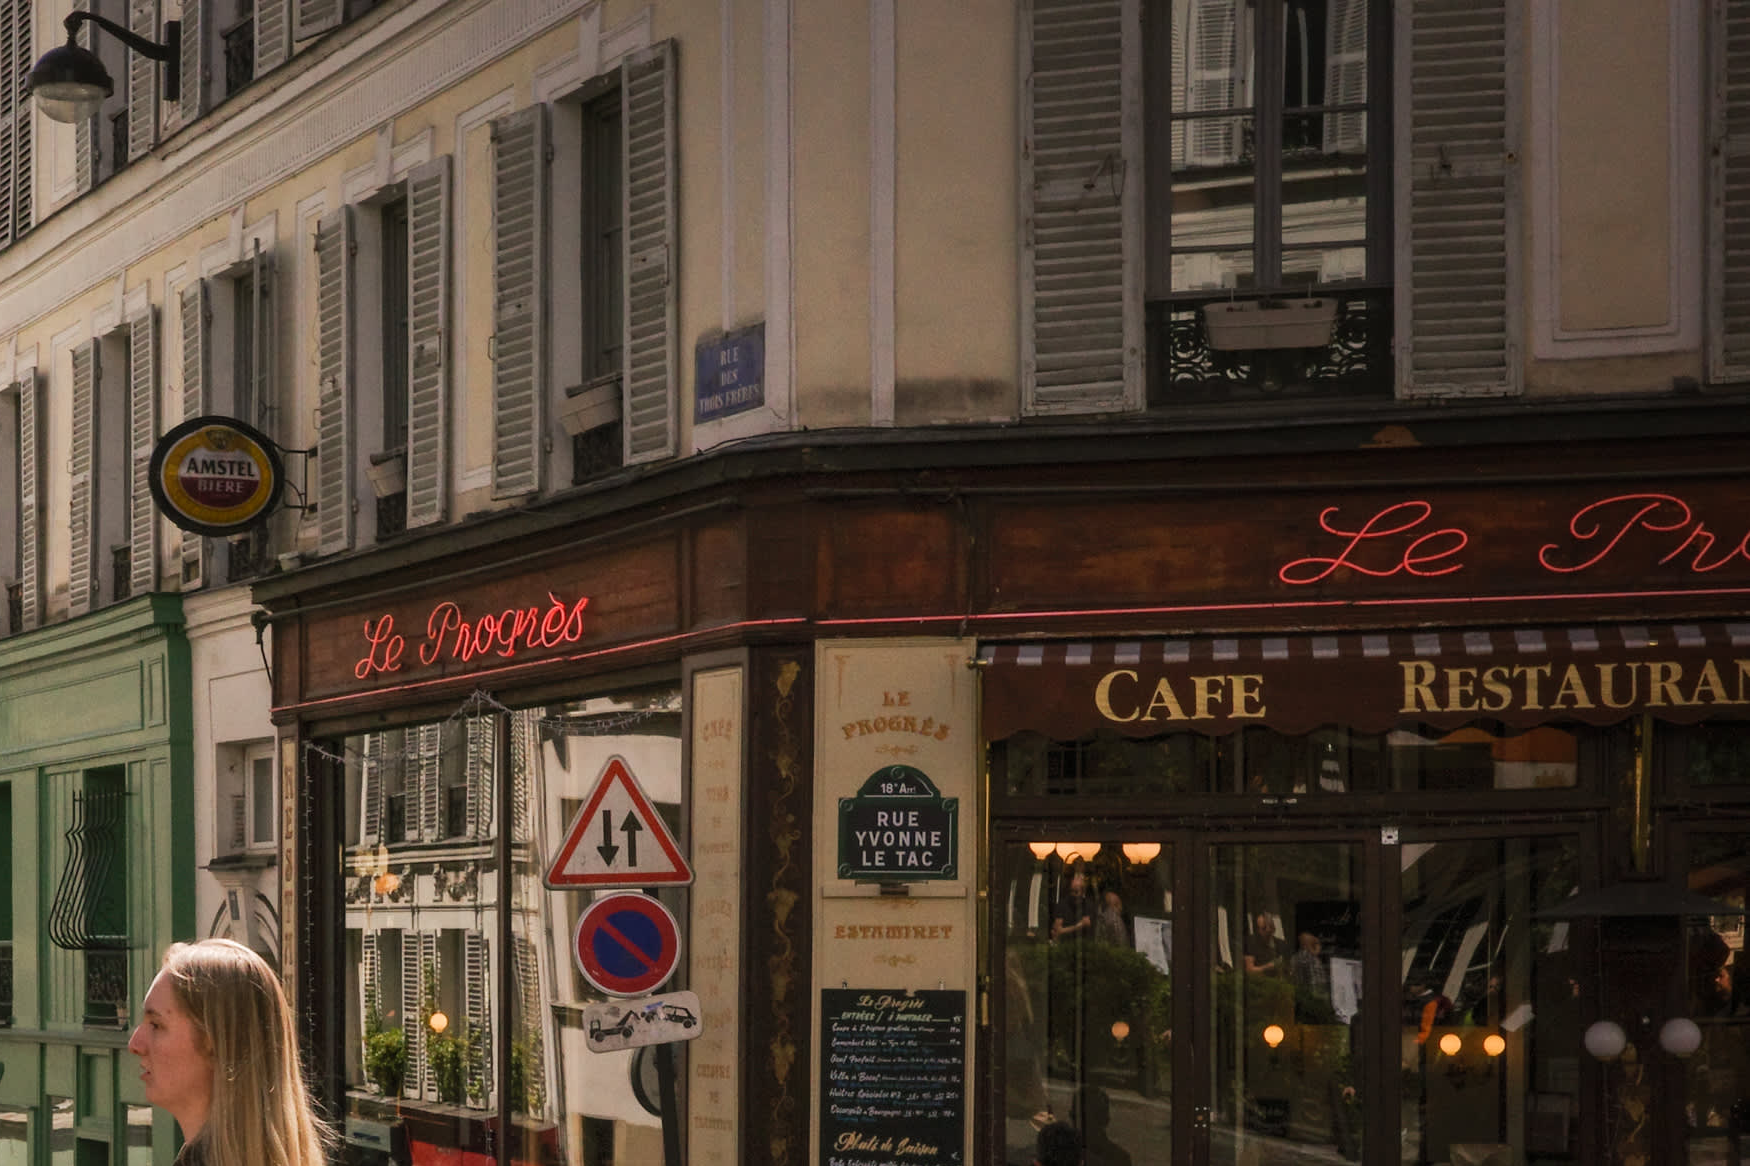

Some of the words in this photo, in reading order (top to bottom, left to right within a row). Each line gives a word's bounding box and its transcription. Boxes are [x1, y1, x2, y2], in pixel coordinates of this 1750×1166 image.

[186, 458, 255, 477] AMSTEL
[1280, 501, 1468, 584] Le
[355, 614, 404, 679] Le
[419, 592, 589, 665] Progrès
[882, 690, 911, 707] LE
[1094, 669, 1267, 722] CAFE
[877, 811, 919, 827] RUE
[855, 831, 942, 847] YVONNE
[862, 851, 886, 867] LE
[896, 851, 934, 867] TAC
[834, 1131, 878, 1152] Plats
